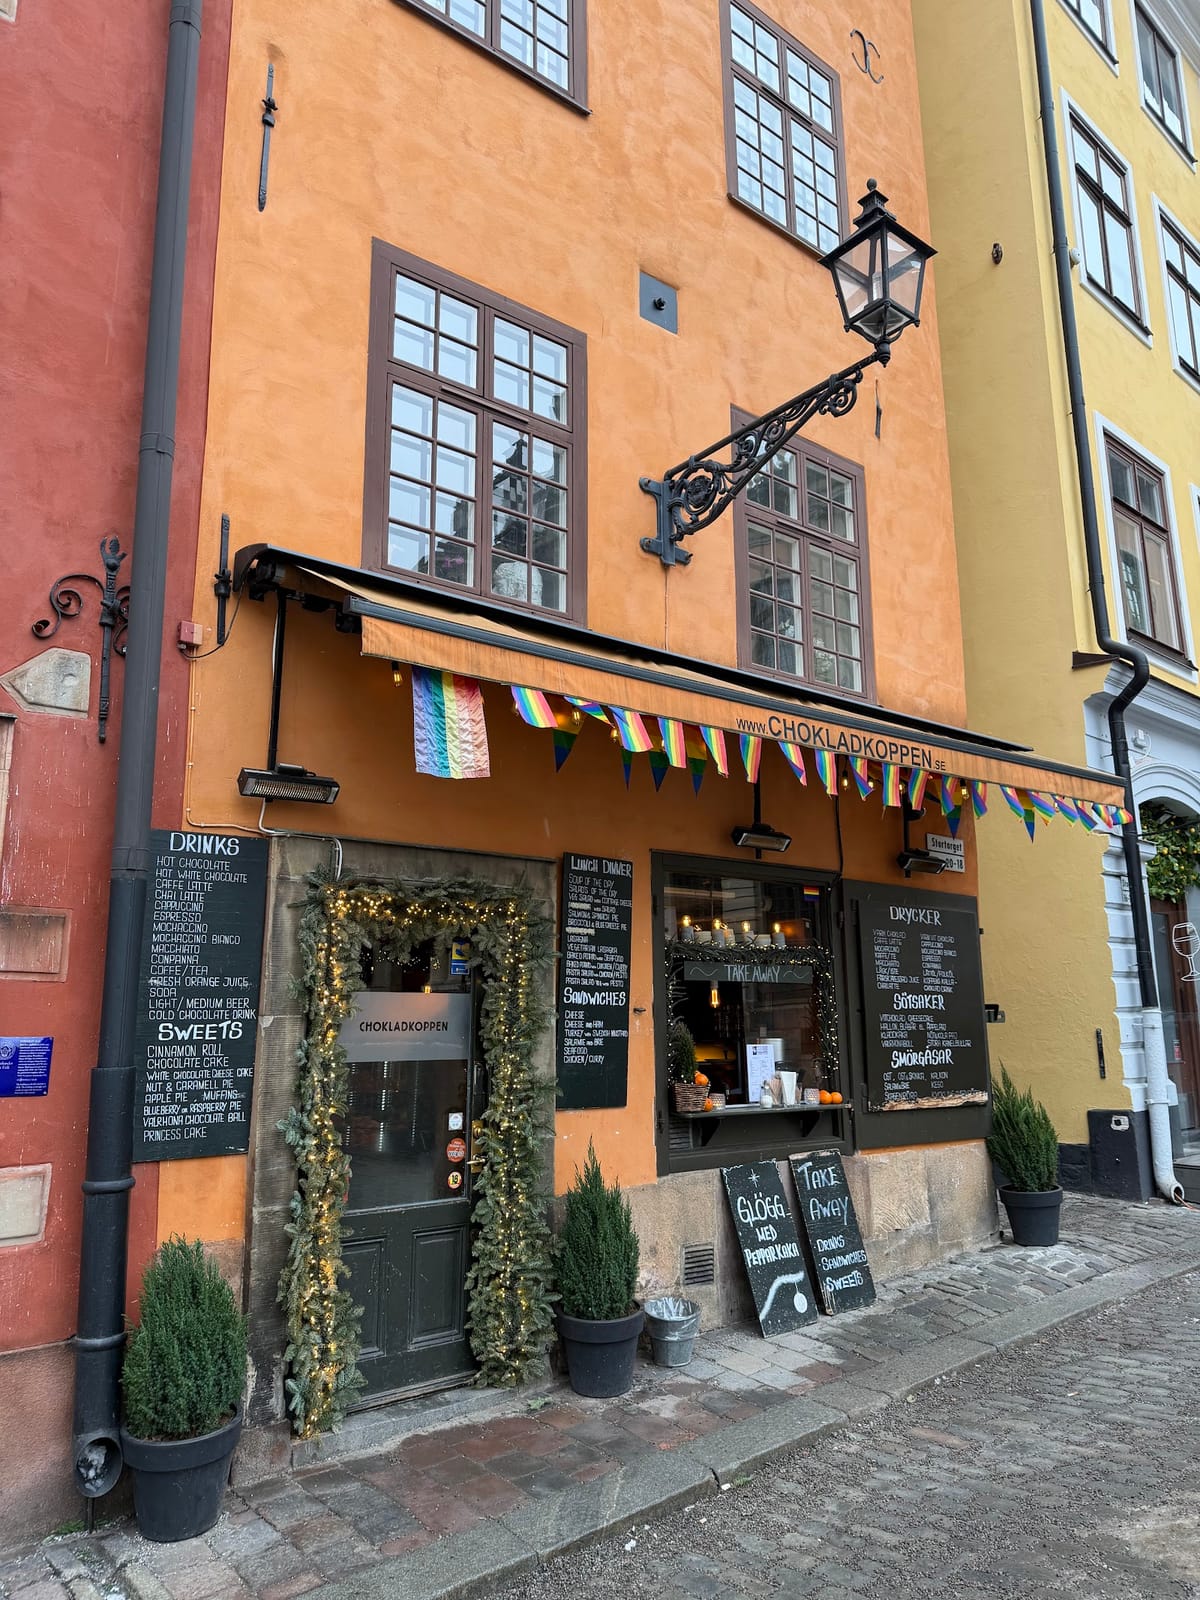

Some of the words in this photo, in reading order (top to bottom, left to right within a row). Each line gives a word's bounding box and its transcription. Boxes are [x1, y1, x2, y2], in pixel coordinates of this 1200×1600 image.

[170, 832, 240, 855] DRINKS
[931, 838, 962, 853] Stortorget
[157, 856, 176, 867] HOT
[179, 858, 230, 871] CHOCOLATE
[571, 855, 598, 873] LUNCH
[603, 860, 631, 878] DINNER
[156, 869, 173, 878] HOT
[178, 870, 201, 880] WHITE
[205, 871, 247, 883] CHOCOLATE
[569, 873, 583, 885] SOUP
[585, 877, 591, 885] OF
[593, 878, 602, 888] THE
[156, 879, 184, 890] CAFFE
[188, 882, 213, 891] LATTE
[155, 890, 176, 900] CHAI
[180, 892, 205, 902] LATTE
[155, 901, 204, 912] CAPPUCCINO
[154, 912, 201, 922] ESPRESSO
[889, 906, 942, 926] DRYCKER
[153, 923, 208, 933] MOCHACCINO
[568, 918, 590, 927] BROCCOLI
[153, 934, 207, 943] MOCHACCINO
[212, 935, 240, 945] BIANCO
[151, 945, 200, 954] MACCHIATO
[567, 943, 596, 952] VEGETARIAN
[151, 954, 199, 965] CONPANNA
[604, 954, 624, 962] SEAFOOD
[151, 965, 208, 976] COFFE/TEA
[724, 964, 751, 982] TAKE
[752, 966, 781, 983] AWAY
[149, 976, 180, 987] FRESH
[185, 977, 220, 987] ORANGE
[223, 977, 248, 987] JUICE
[581, 978, 594, 986] SALAD
[150, 988, 176, 997] SODA
[564, 987, 626, 1006] SANDWICHES
[226, 998, 249, 1009] BEER
[894, 992, 945, 1010] SÖTSAKER
[149, 1010, 174, 1020] COLD
[179, 1010, 229, 1020] CHOCOLATE
[233, 1009, 256, 1019] DRINK
[565, 1010, 584, 1019] CHEESE
[159, 1020, 243, 1040] SWEETS
[359, 1021, 449, 1032] CHOKLADKOPPEN
[565, 1020, 584, 1028] CHEESE
[593, 1020, 603, 1028] HAM
[565, 1029, 584, 1037] TURKEY
[147, 1044, 197, 1057] CINNAMON
[202, 1044, 224, 1056] ROLL
[564, 1047, 587, 1055] SEAFOOD
[891, 1045, 954, 1068] SMÖRGÅSAR
[147, 1058, 200, 1069] CHOCOLATE
[203, 1057, 229, 1067] CAKE
[146, 1071, 170, 1080] WHITE
[174, 1070, 211, 1080] CHOCOLATE
[212, 1069, 233, 1078] CHEESE
[237, 1068, 253, 1077] CAKE
[146, 1082, 162, 1092] NUT
[166, 1083, 172, 1091] &
[176, 1080, 218, 1090] CARAMELL
[223, 1079, 233, 1088] PIE
[145, 1093, 171, 1103] APPLE
[144, 1105, 180, 1116] BLUEBERRY
[190, 1102, 227, 1113] RASPBERRY
[230, 1101, 241, 1111] PIE
[143, 1114, 183, 1127] VALRHONA
[185, 1113, 224, 1125] CHOCOLATE
[228, 1112, 246, 1122] BALL
[143, 1129, 181, 1142] PRINCESS
[184, 1127, 207, 1138] CAKE
[798, 1162, 842, 1190] TAKE
[737, 1192, 786, 1227] GLÖGG
[810, 1196, 849, 1225] AWAY
[756, 1224, 778, 1242] MED
[816, 1235, 845, 1252] DRINKS
[744, 1242, 799, 1267] PEPPARKAKA
[821, 1250, 867, 1271] SANDWICHES
[825, 1270, 864, 1292] SWEETS
